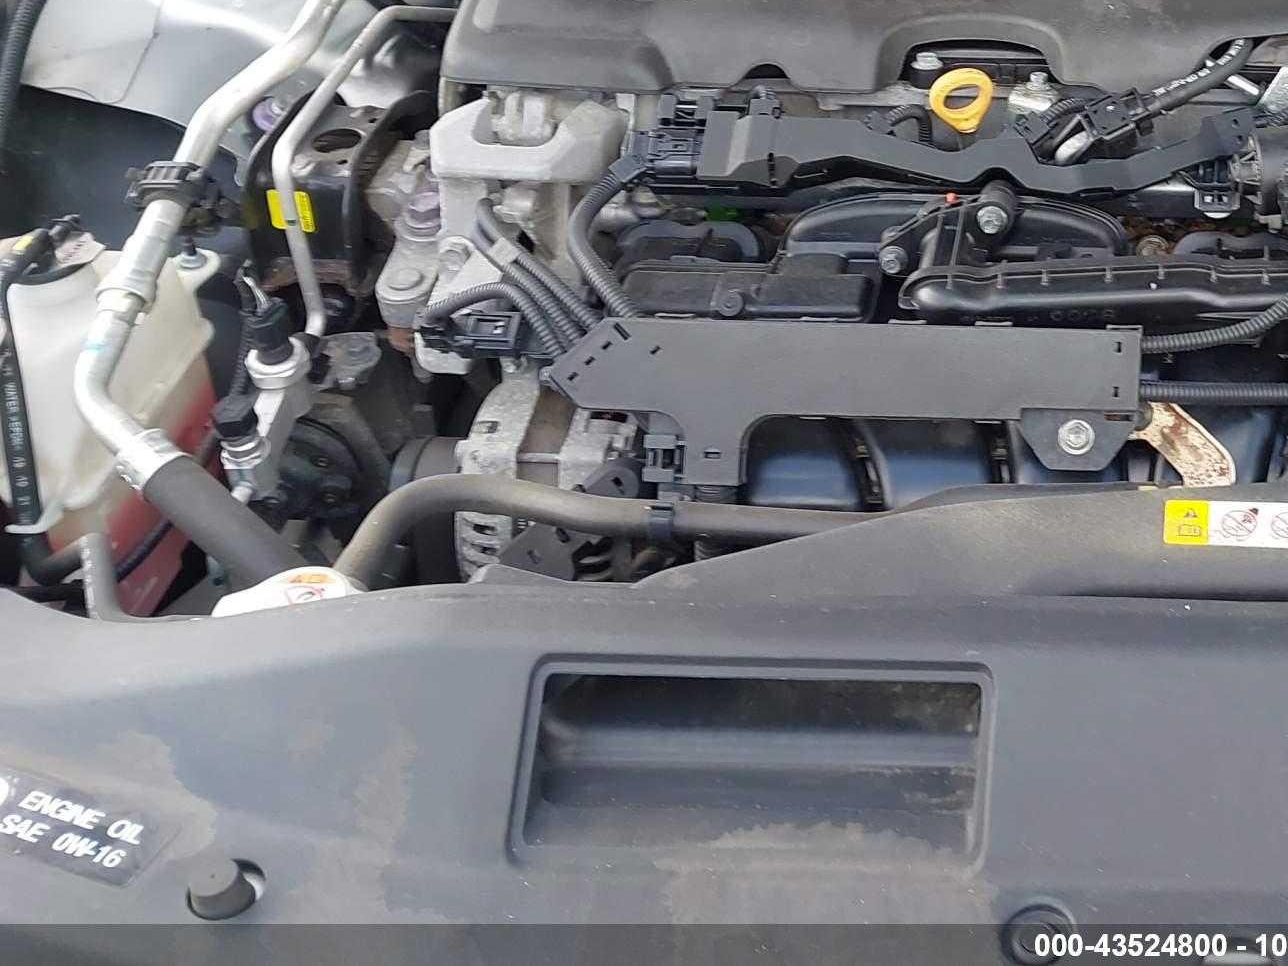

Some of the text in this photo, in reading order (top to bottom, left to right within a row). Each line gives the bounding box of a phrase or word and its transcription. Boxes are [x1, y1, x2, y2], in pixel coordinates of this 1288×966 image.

[0, 814, 126, 868] SAE 0W-16
[18, 790, 144, 845] ENGINE OIL
